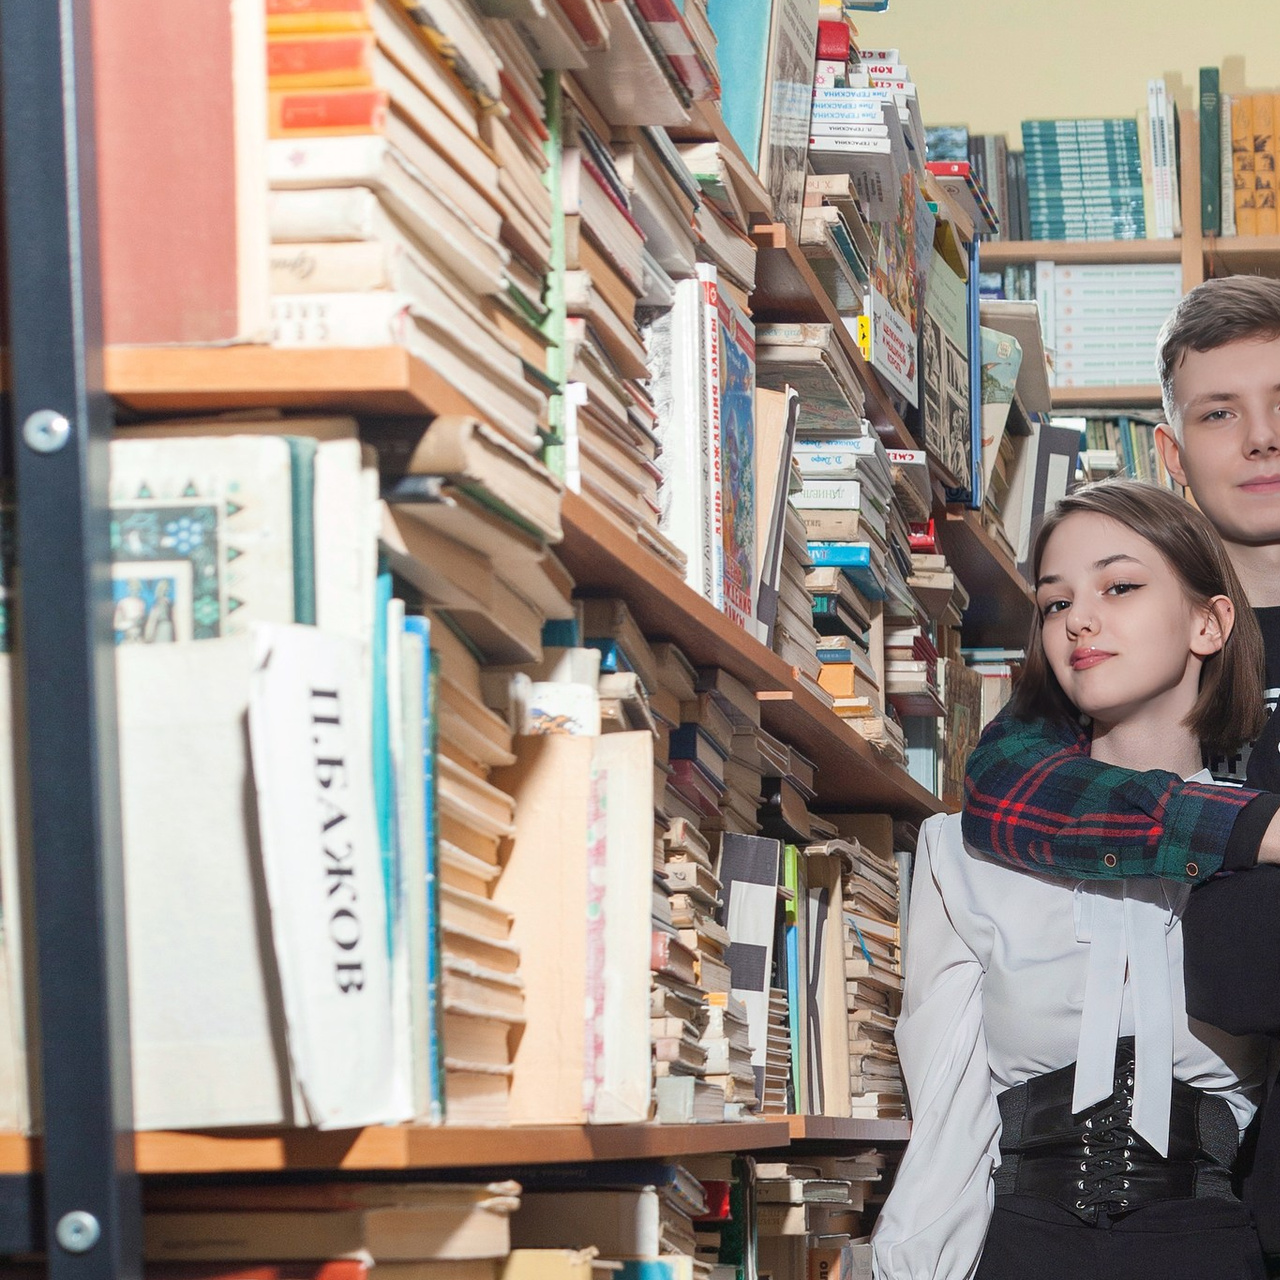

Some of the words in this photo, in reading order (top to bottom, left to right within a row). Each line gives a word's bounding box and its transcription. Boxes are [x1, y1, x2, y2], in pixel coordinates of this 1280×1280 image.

[870, 66, 892, 74] КОР
[712, 384, 721, 483] РОЖДЕНИЯ
[811, 455, 832, 465] Дефо
[307, 685, 368, 996] П.БАЖОВ
